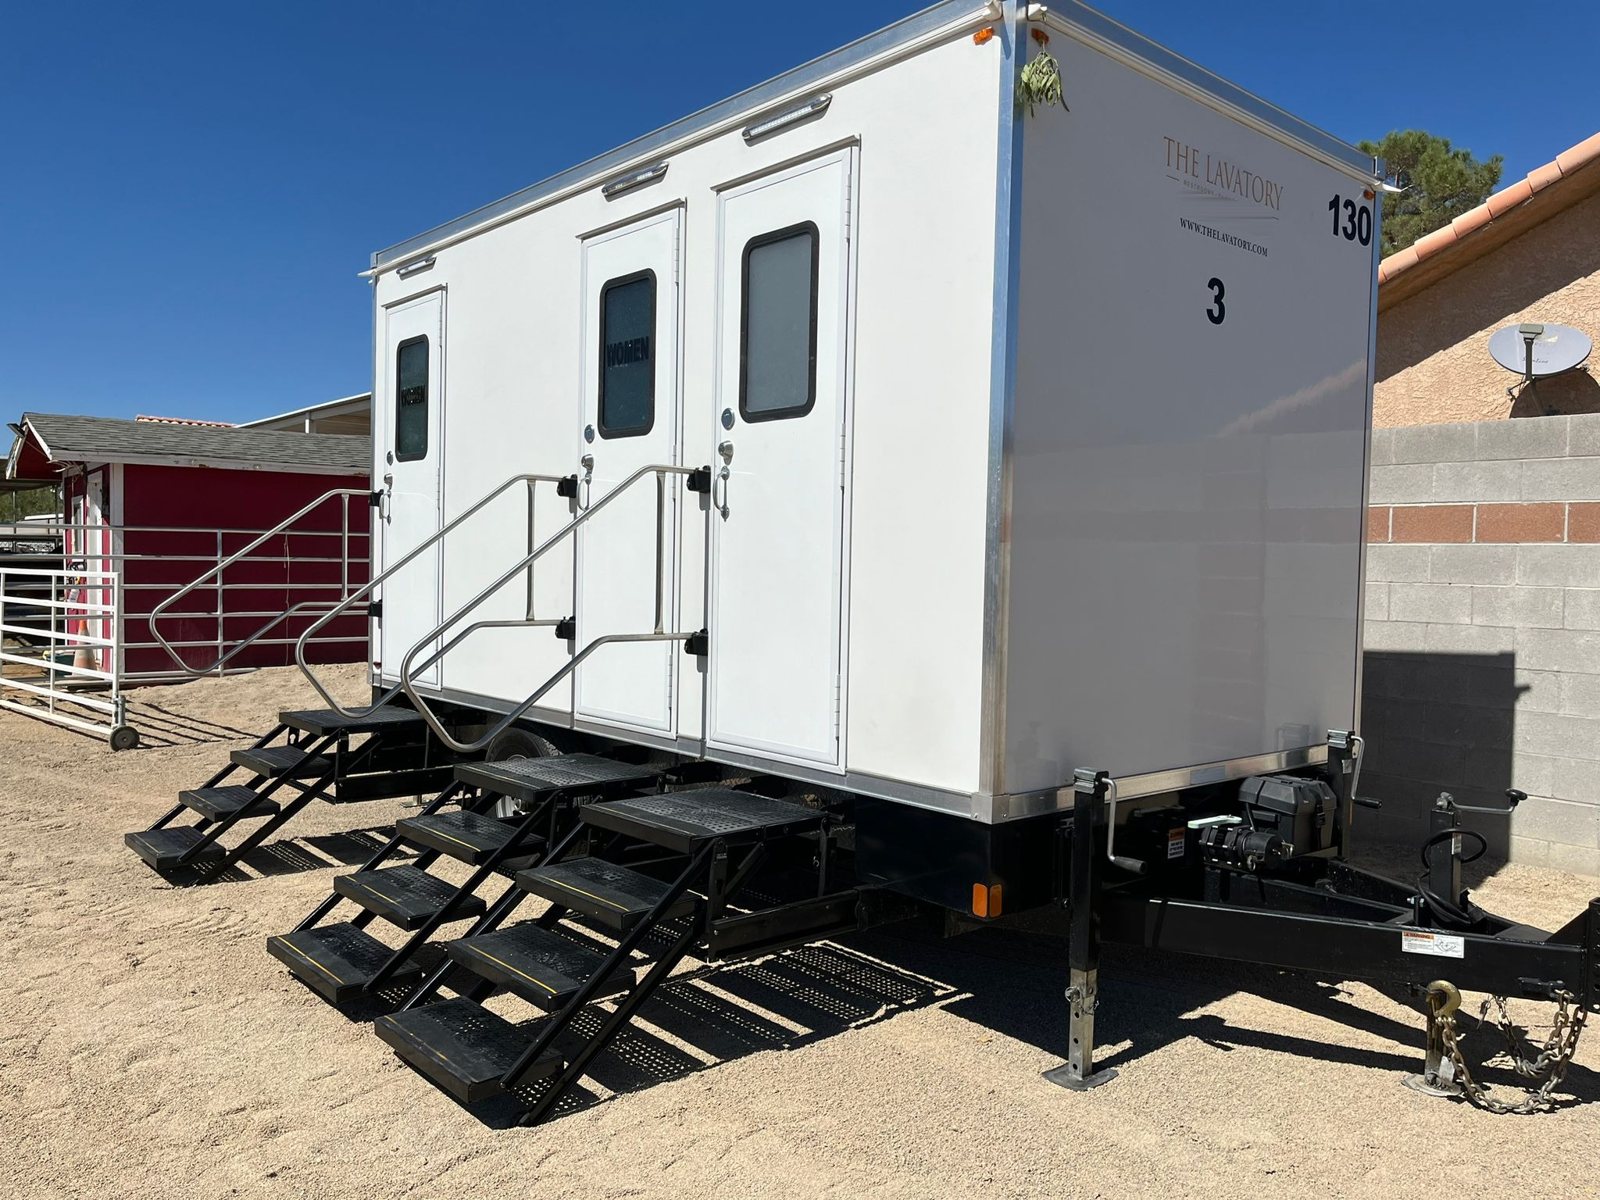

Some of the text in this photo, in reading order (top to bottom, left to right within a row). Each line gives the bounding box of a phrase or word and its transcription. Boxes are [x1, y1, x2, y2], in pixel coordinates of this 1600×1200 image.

[1163, 136, 1199, 178] THE
[1206, 154, 1284, 211] LAVATORY
[1180, 217, 1268, 257] WWW.THELAVATORY.COM
[1328, 193, 1372, 247] 130
[1206, 277, 1226, 325] 3
[606, 335, 649, 368] WOMEN
